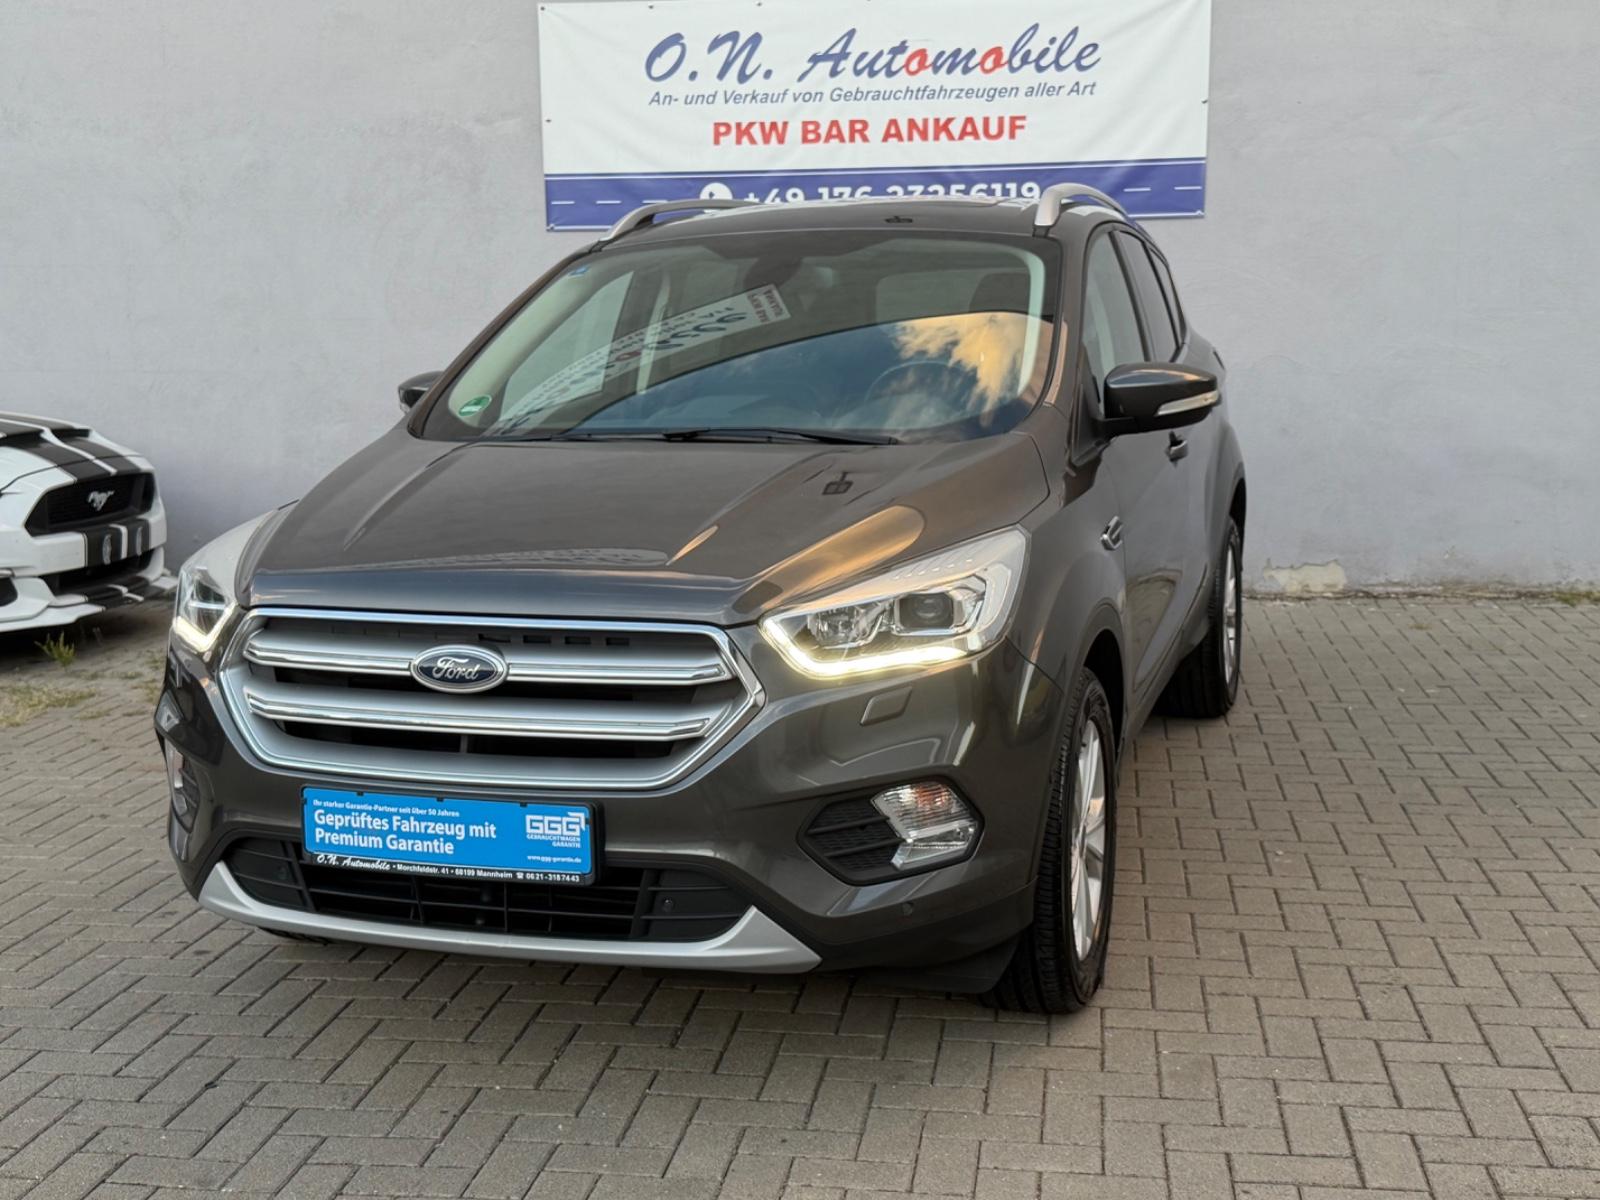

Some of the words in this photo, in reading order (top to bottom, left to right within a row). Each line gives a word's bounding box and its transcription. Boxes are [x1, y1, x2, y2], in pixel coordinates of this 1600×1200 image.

[797, 22, 1101, 83] Automobile
[648, 90, 679, 106] An-
[684, 90, 718, 105] und
[723, 88, 790, 104] Verkauf
[792, 91, 825, 104] von
[829, 84, 1020, 103] Gebrauchtfahrzeugen
[1024, 82, 1066, 98] aller
[1067, 80, 1098, 97] Art
[713, 121, 789, 146] PKW
[801, 119, 871, 145] BAR
[881, 115, 1028, 143] ANKAUF
[432, 656, 481, 680] Ford
[313, 799, 323, 807] Ihr
[323, 800, 345, 809] starker
[345, 802, 398, 814] Garantie-Partner
[399, 807, 411, 815] seit
[411, 807, 427, 816] über
[428, 808, 436, 816] 50
[437, 809, 460, 818] Jahren
[314, 809, 390, 831] Geprüftes
[392, 815, 466, 840] Fahrzeug
[468, 821, 497, 839] mit
[315, 827, 383, 849] Premium
[386, 834, 454, 855] Garantie
[526, 833, 581, 843] GEBRAUCHTWAGEN
[341, 856, 391, 871] Automobile
[441, 866, 449, 875] 41
[476, 871, 513, 879] Mannheim
